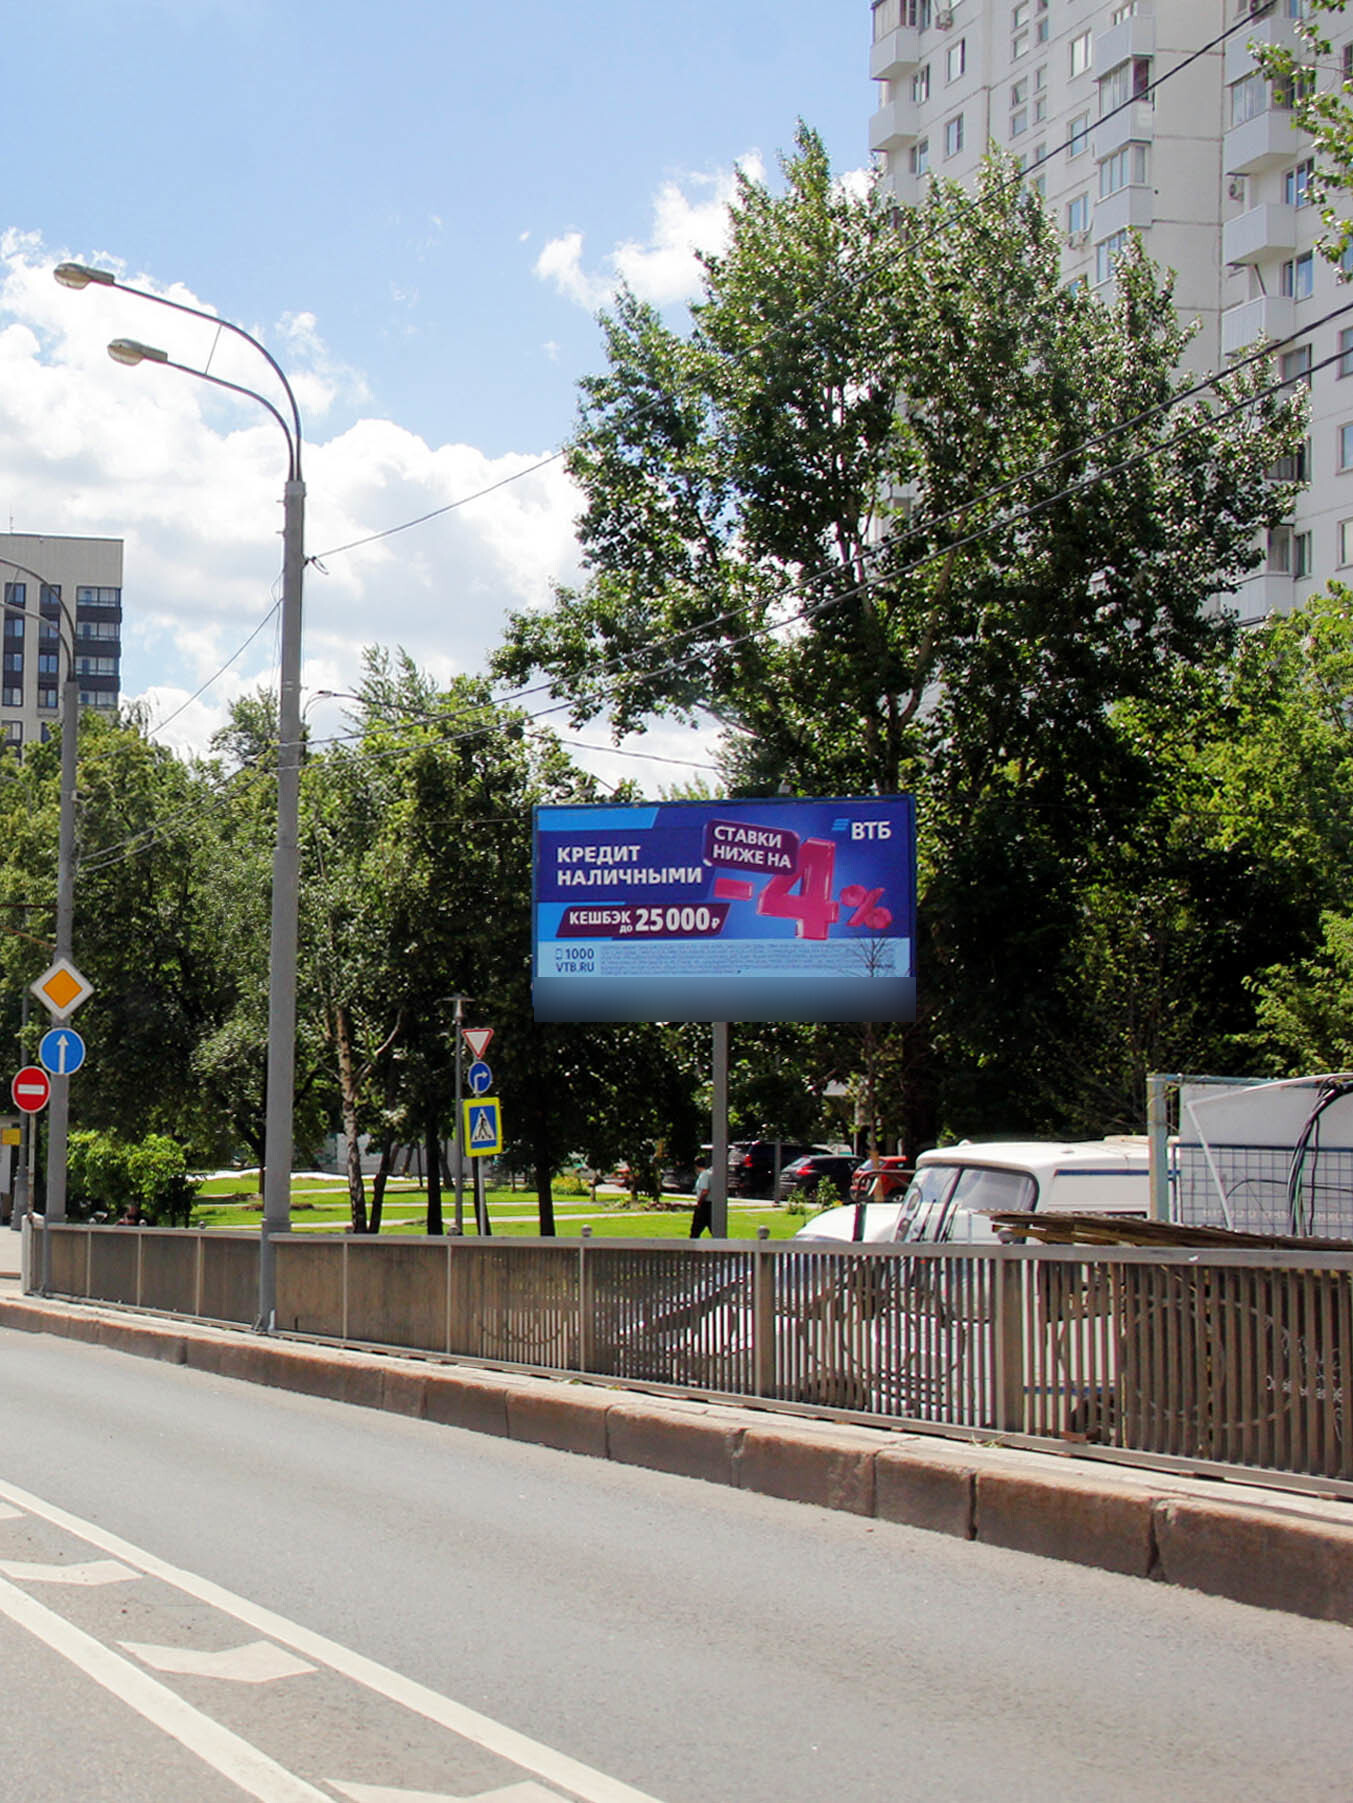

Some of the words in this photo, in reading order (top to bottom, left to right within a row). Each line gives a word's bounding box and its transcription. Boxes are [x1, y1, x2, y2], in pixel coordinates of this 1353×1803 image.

[714, 825, 782, 848] СТАВКИ
[851, 821, 891, 840] ВТБ
[557, 845, 640, 865] КРЕДИТ
[713, 844, 765, 865] НИЖЕ
[767, 854, 792, 868] НА
[557, 867, 702, 886] НАЛИЧНЫМИ
[569, 911, 631, 925] КЕШБЭК
[565, 948, 594, 959] 1000
[556, 962, 595, 973] VTB.RU
